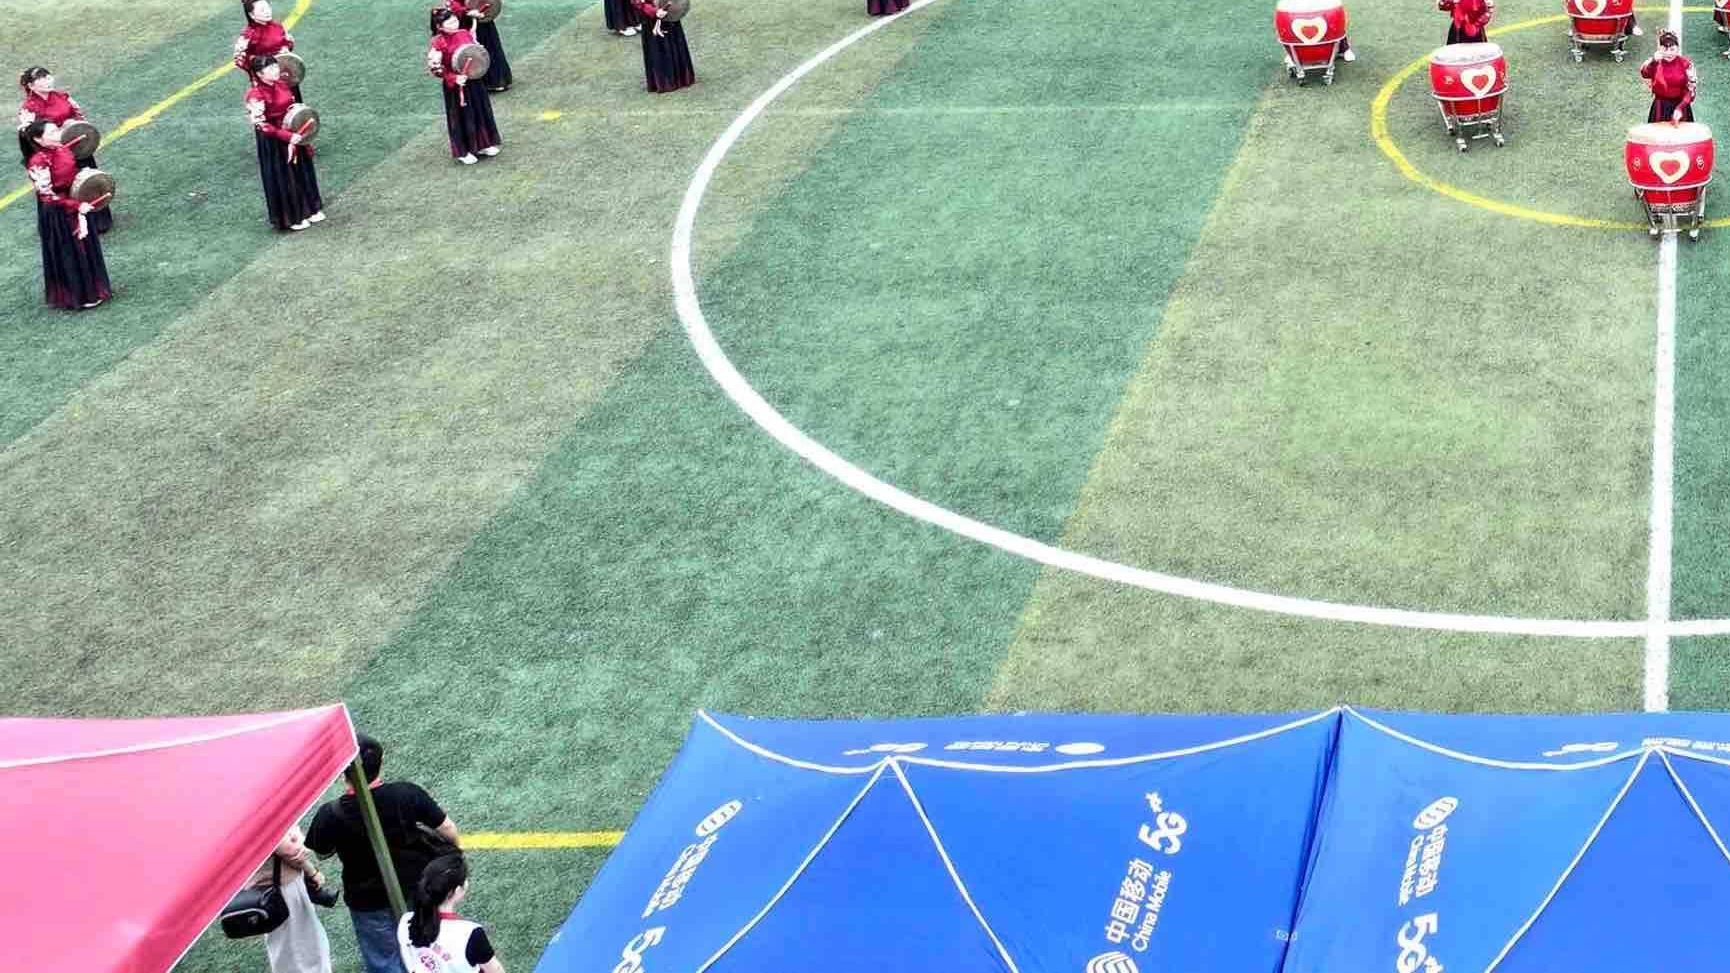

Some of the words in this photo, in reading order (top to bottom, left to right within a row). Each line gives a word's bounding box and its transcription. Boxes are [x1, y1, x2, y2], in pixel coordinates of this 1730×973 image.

[1104, 857, 1154, 944] 中国移动
[1144, 870, 1172, 913] Mobile
[1131, 910, 1158, 953] China
